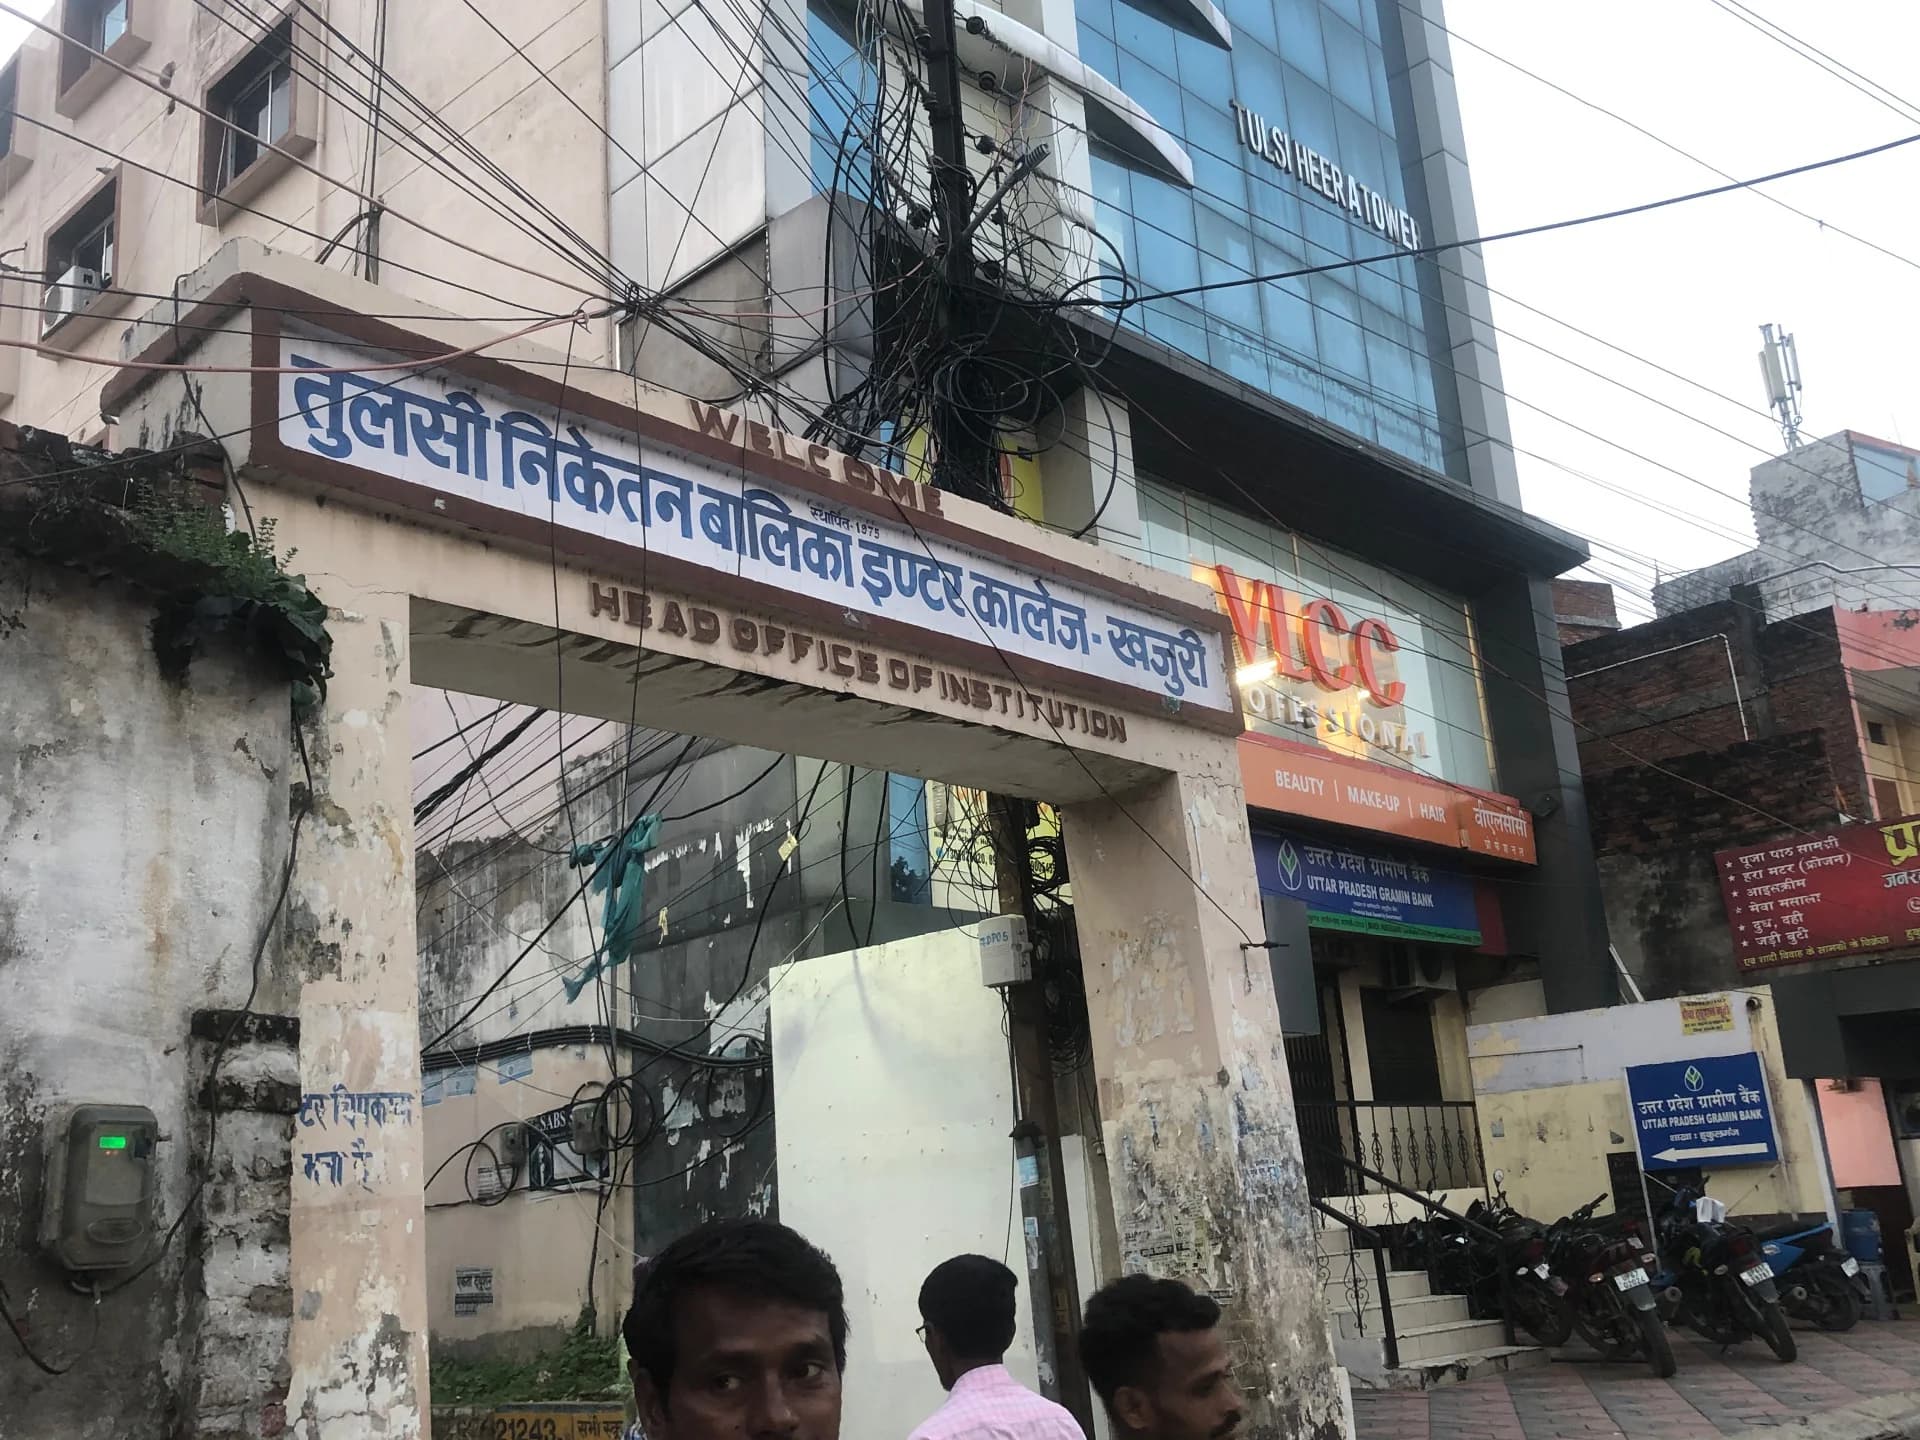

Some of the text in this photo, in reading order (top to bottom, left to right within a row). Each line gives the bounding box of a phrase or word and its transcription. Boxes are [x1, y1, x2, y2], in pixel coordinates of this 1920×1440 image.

[1229, 99, 1292, 174] TULSI
[1294, 140, 1362, 218] HEERA
[690, 398, 945, 518] WELCOME
[291, 354, 489, 482] तुलसी
[496, 411, 693, 539] निकेतन
[698, 488, 854, 588] बालिका
[859, 539, 967, 617] इण्टर
[1106, 615, 1209, 697] खजुरी
[1219, 563, 1407, 708] VLCC
[590, 582, 1128, 744] HEAD OFFICE OF INSTITUTION
[1275, 769, 1446, 824] BEAUTY MAKE-UP HAIR
[1304, 846, 1335, 869] उत्तर
[1336, 848, 1366, 873] प्रदेश
[1739, 852, 1765, 869] पूजा
[1769, 847, 1794, 859] पाठ
[1307, 874, 1338, 893] UTTAR
[1339, 879, 1378, 900] PRADESH
[1379, 886, 1411, 904] GRAMIN
[1411, 892, 1434, 908] BANK
[1742, 869, 1764, 883] हरा
[1881, 869, 1920, 888] जनर
[1637, 1084, 1761, 1115] उत्तर प्रदेश ग्रामीण बैंक
[1641, 1108, 1763, 1130] UTTAR PRADESH GRAMIN BANK
